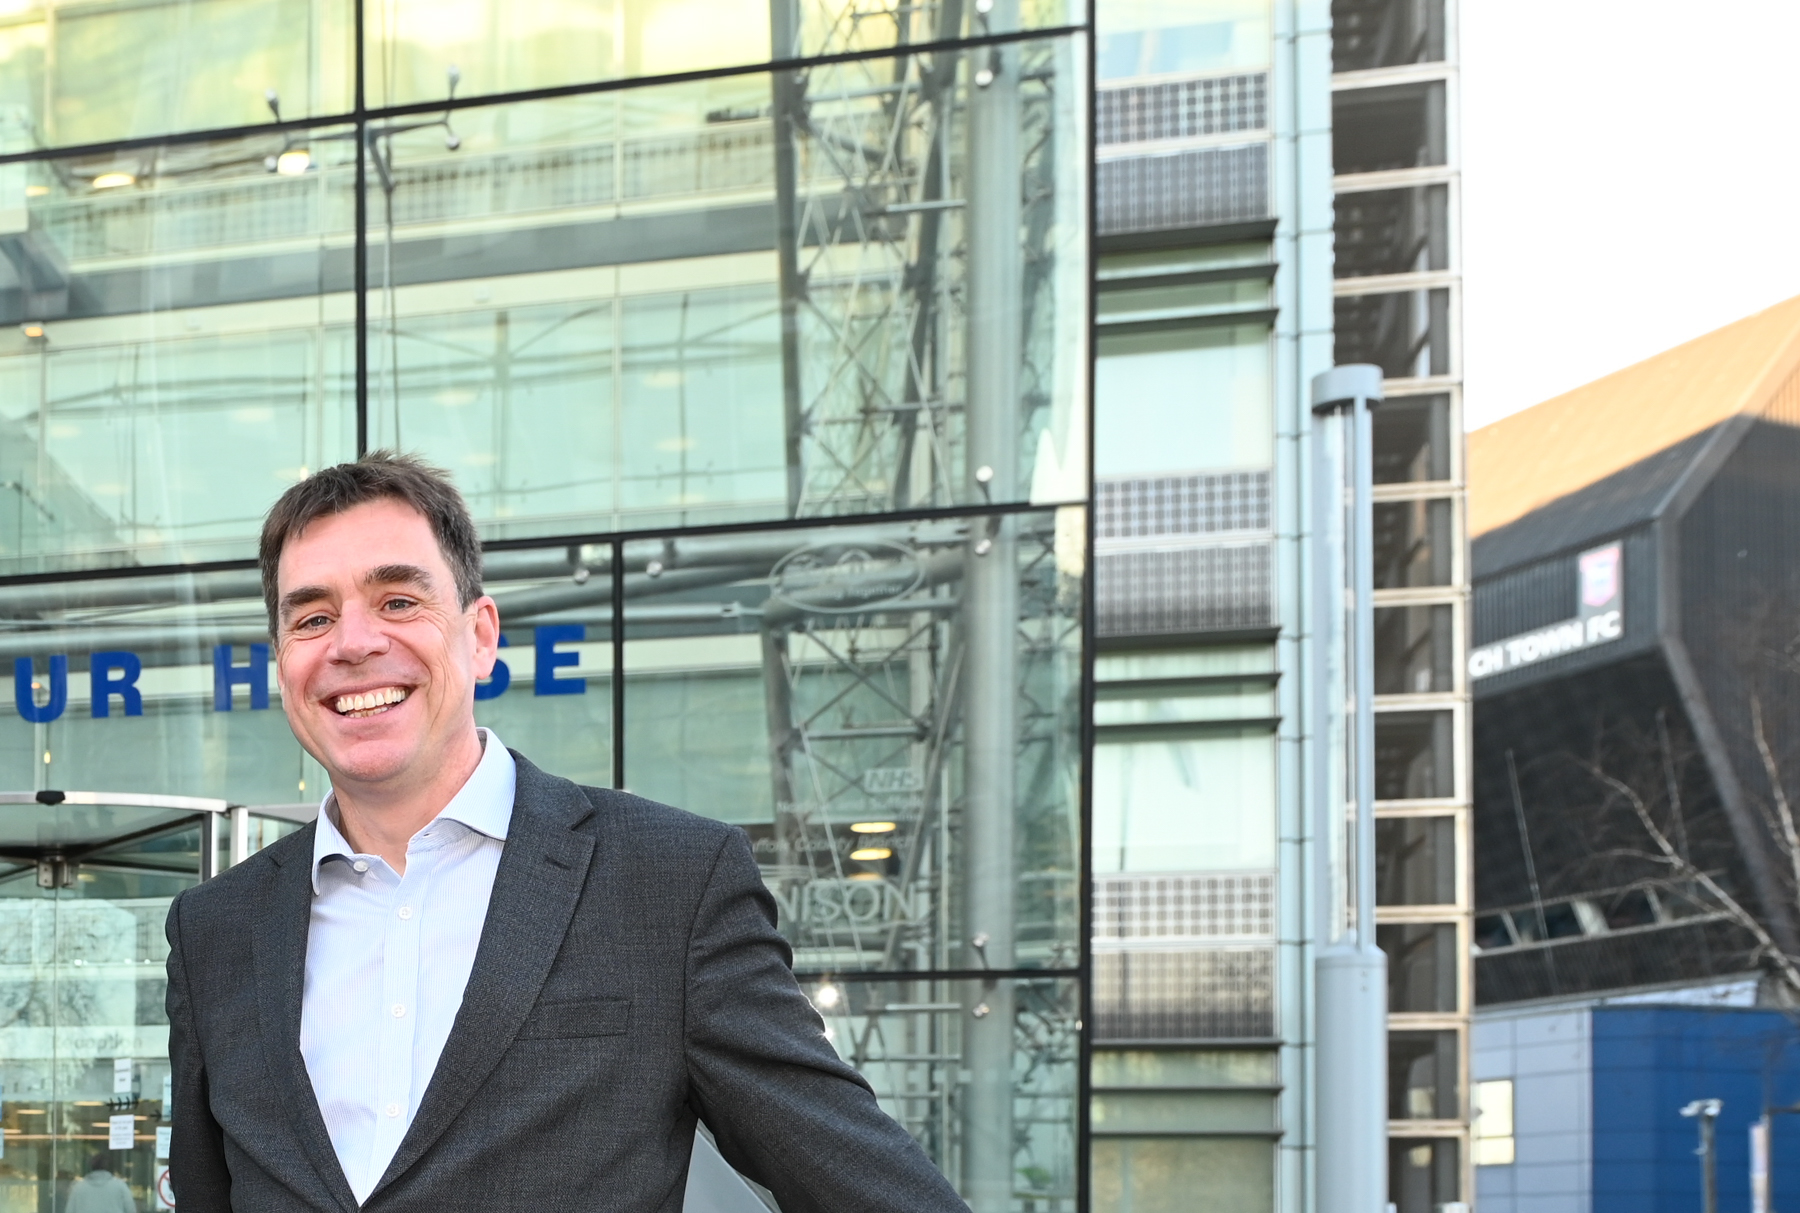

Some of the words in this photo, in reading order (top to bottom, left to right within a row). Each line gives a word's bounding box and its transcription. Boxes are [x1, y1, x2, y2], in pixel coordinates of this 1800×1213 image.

[1505, 621, 1583, 665] TOWN
[1586, 610, 1621, 642] FC
[867, 769, 922, 790] NHS
[774, 881, 917, 924] NISON
